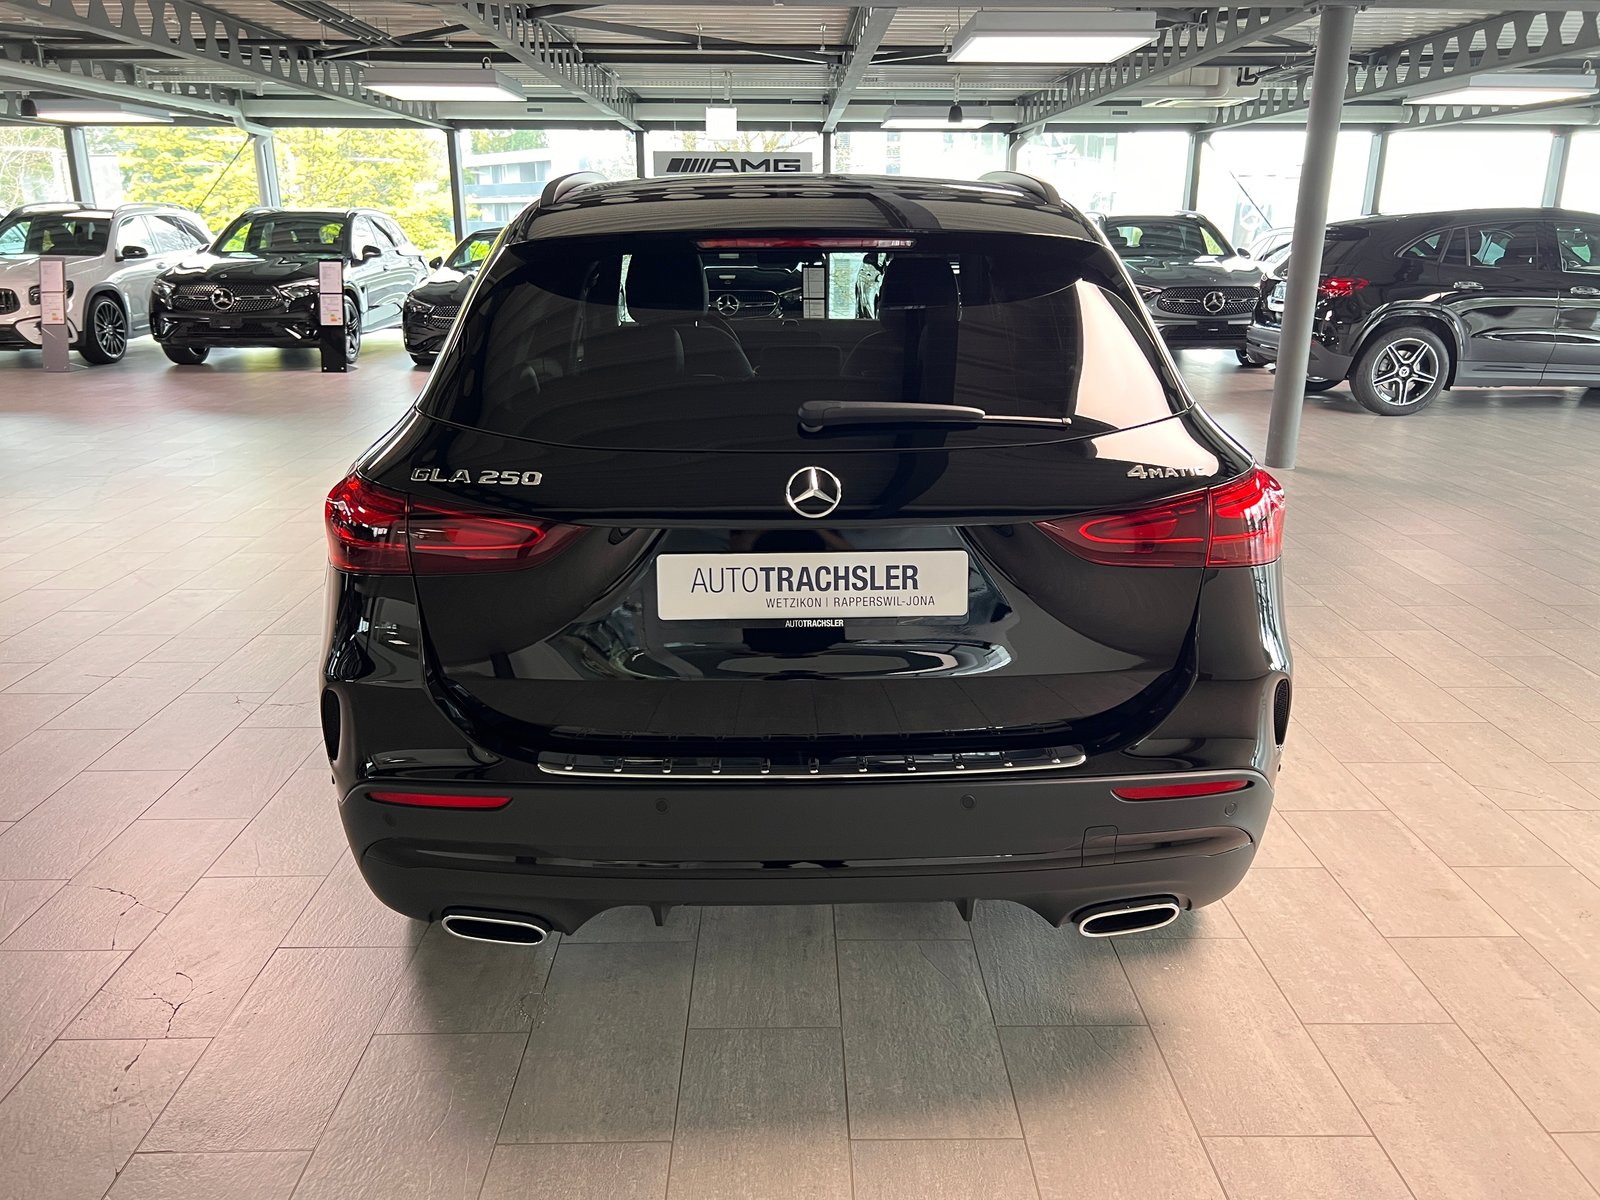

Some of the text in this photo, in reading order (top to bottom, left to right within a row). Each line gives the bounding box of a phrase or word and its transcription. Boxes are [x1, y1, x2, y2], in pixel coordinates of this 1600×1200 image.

[707, 158, 801, 172] AMG
[410, 467, 543, 486] GLA 250
[691, 565, 919, 593] AUTOTRACHSLER
[765, 595, 936, 608] WETZIKON RAPPERSWIL-JONA
[785, 619, 844, 628] AUTOTRACHSLER
